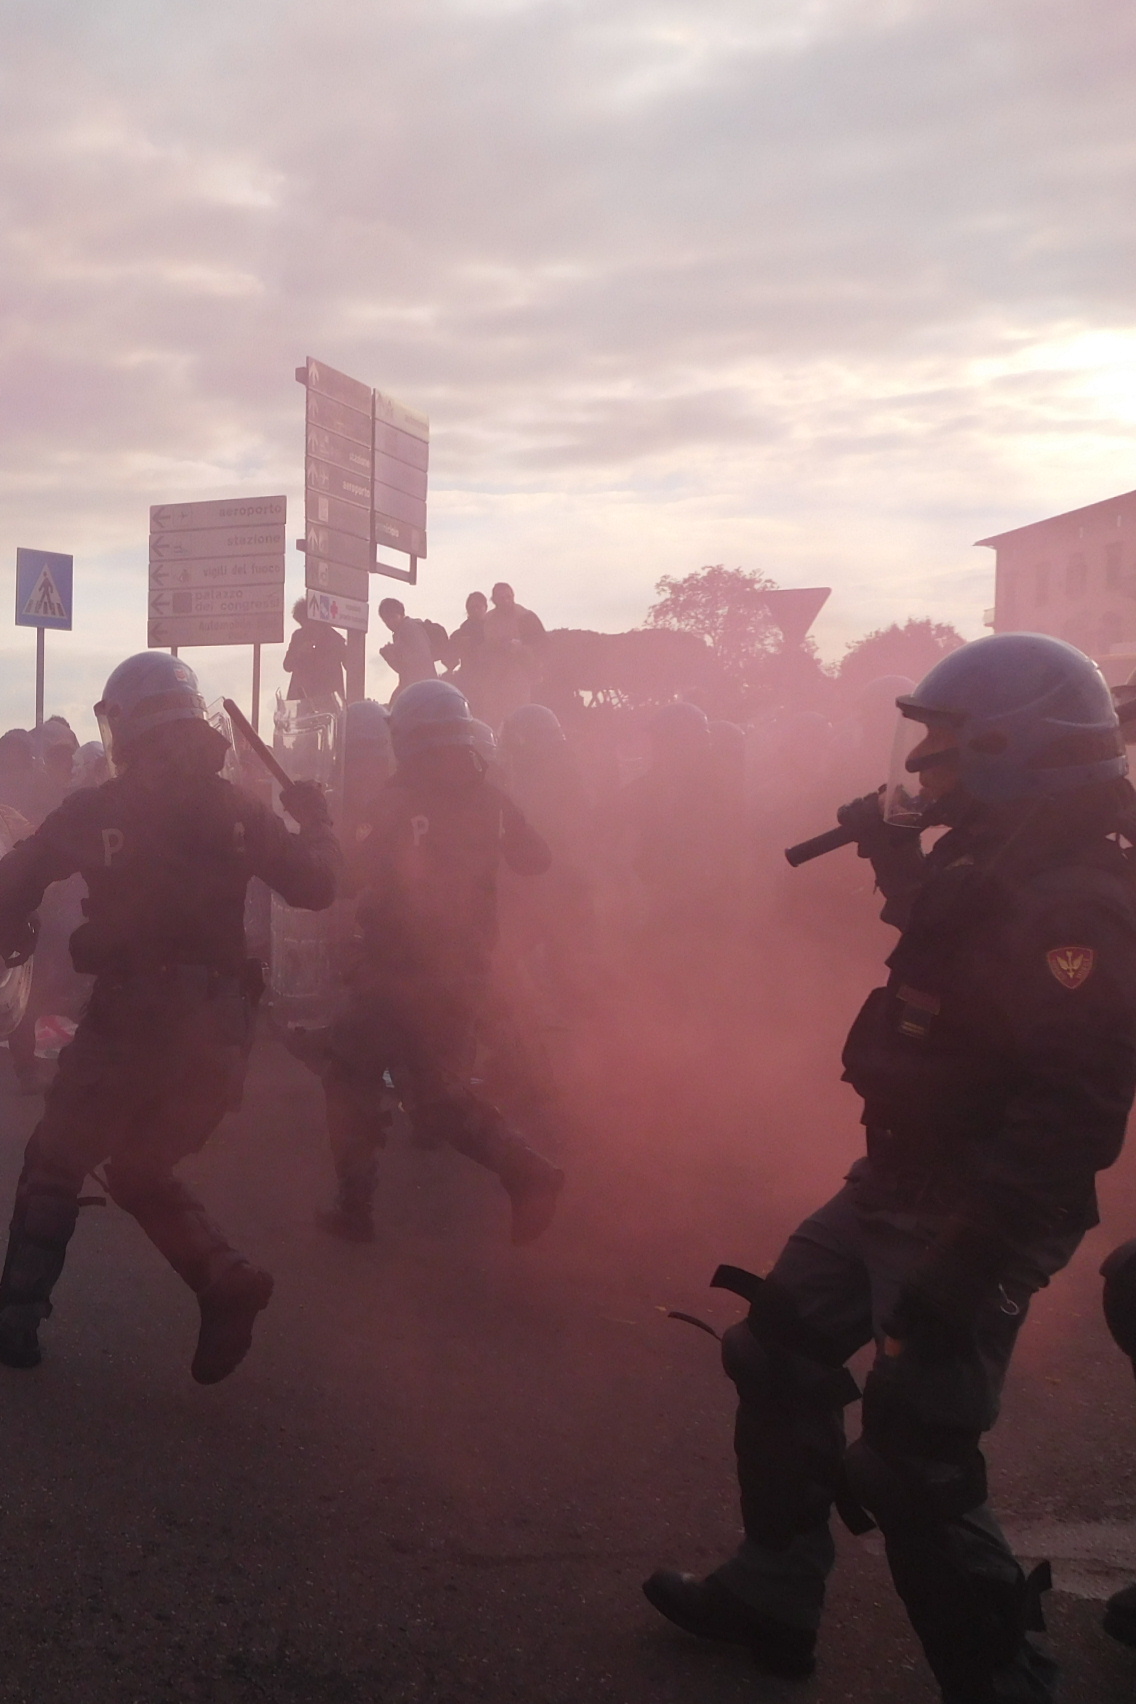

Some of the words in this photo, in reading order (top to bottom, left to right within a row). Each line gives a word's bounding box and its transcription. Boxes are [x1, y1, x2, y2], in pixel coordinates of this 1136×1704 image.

[342, 480, 371, 498] aeroporto
[218, 503, 282, 517] aeroporto
[227, 533, 281, 546] stazione
[203, 566, 227, 579] vigili
[251, 562, 280, 574] fuoco
[195, 588, 243, 601] palazzo
[195, 601, 214, 612] dei
[220, 598, 281, 613] congressi
[411, 814, 430, 847] P
[101, 827, 124, 867] P
